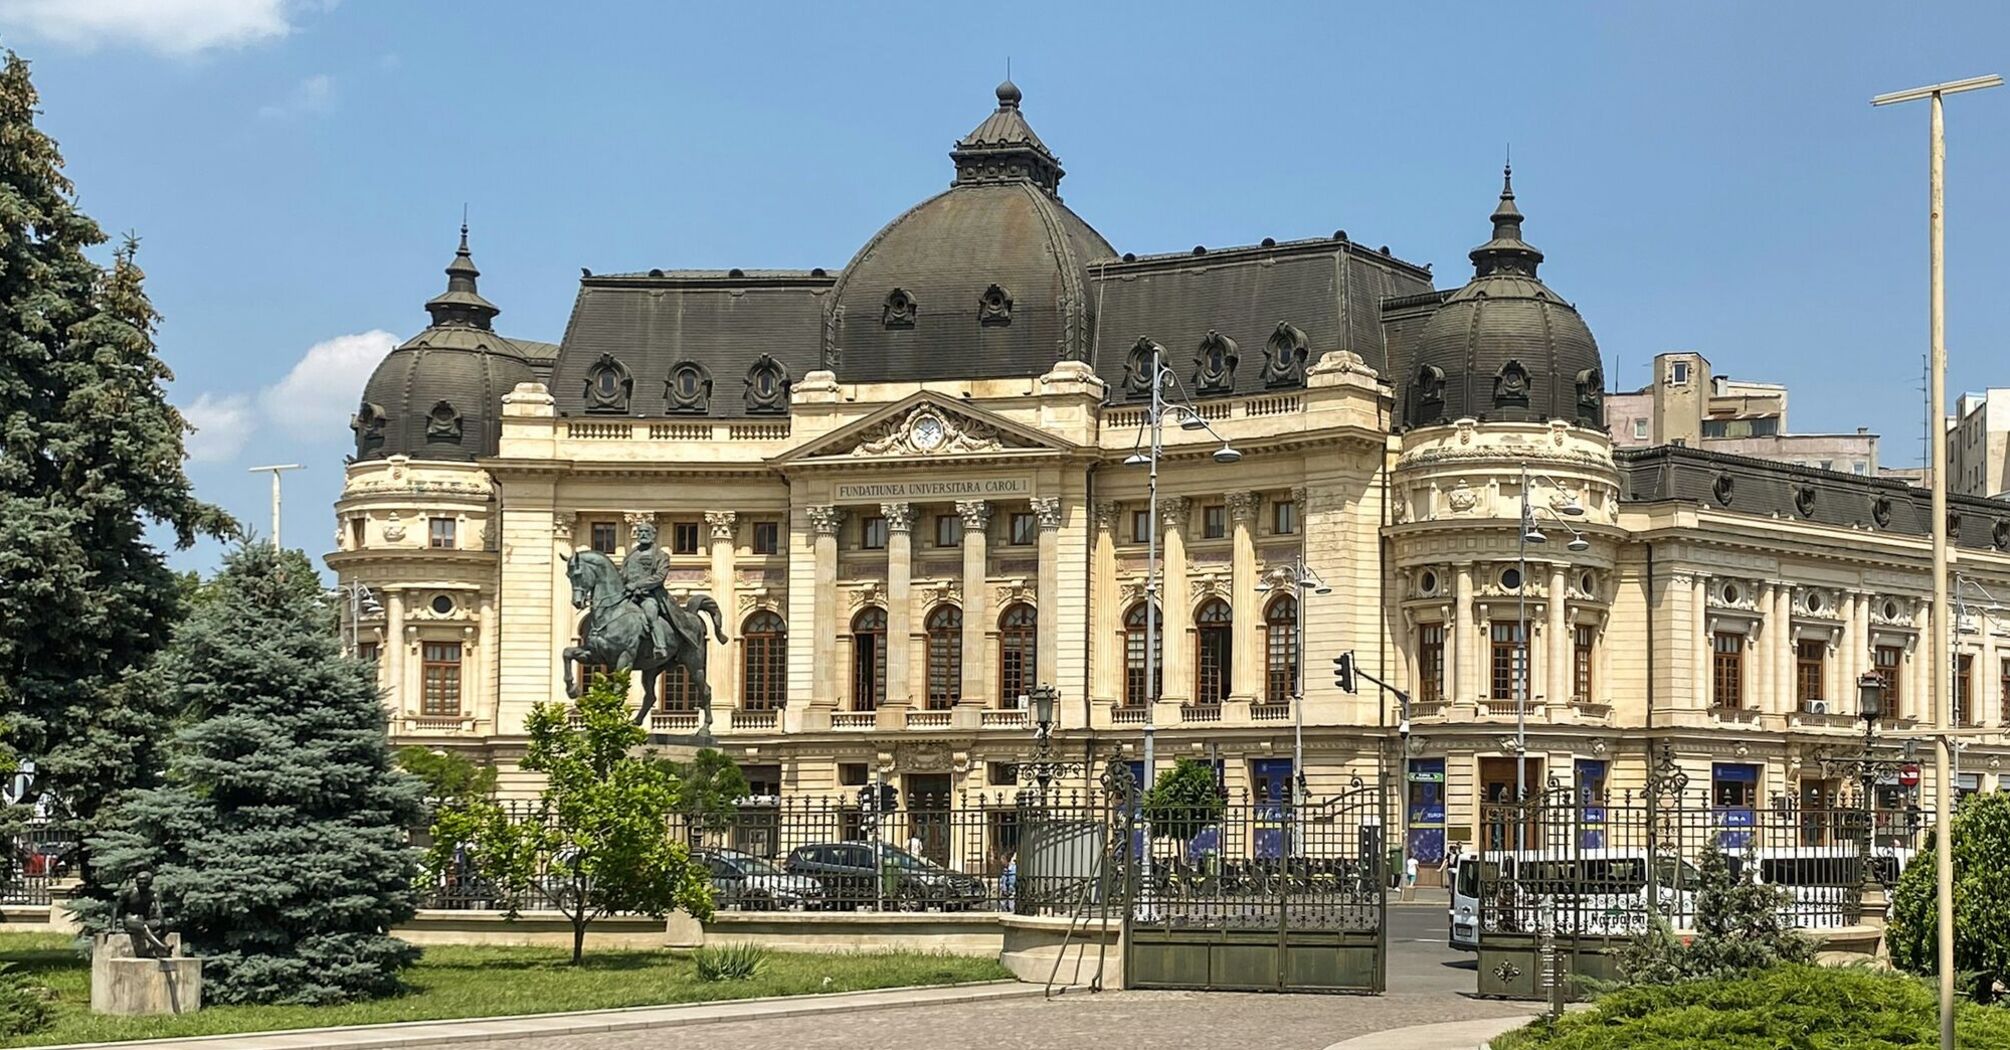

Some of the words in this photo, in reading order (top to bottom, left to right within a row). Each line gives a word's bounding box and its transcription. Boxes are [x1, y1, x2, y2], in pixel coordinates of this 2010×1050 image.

[840, 484, 905, 497] FUNDATIUNEA
[909, 482, 980, 495] UNIVERSITARA
[985, 480, 1019, 492] CAROL
[1022, 479, 1027, 491] I
